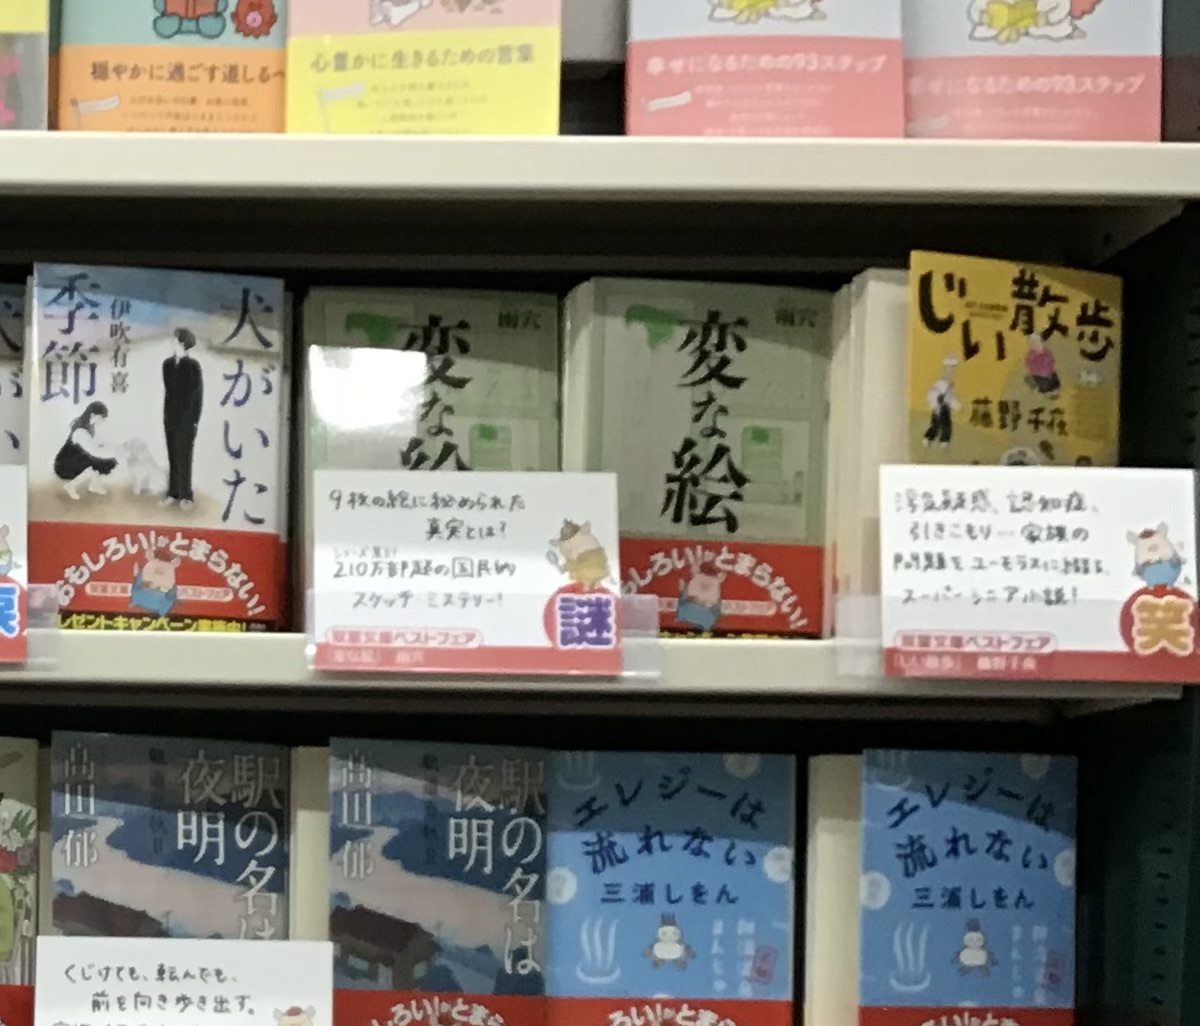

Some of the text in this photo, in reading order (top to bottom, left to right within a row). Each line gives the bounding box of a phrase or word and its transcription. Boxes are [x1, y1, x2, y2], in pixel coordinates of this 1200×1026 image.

[41, 273, 275, 526] 犬がいた 季節
[660, 310, 749, 535] 変な絵
[1134, 597, 1193, 655] 笑
